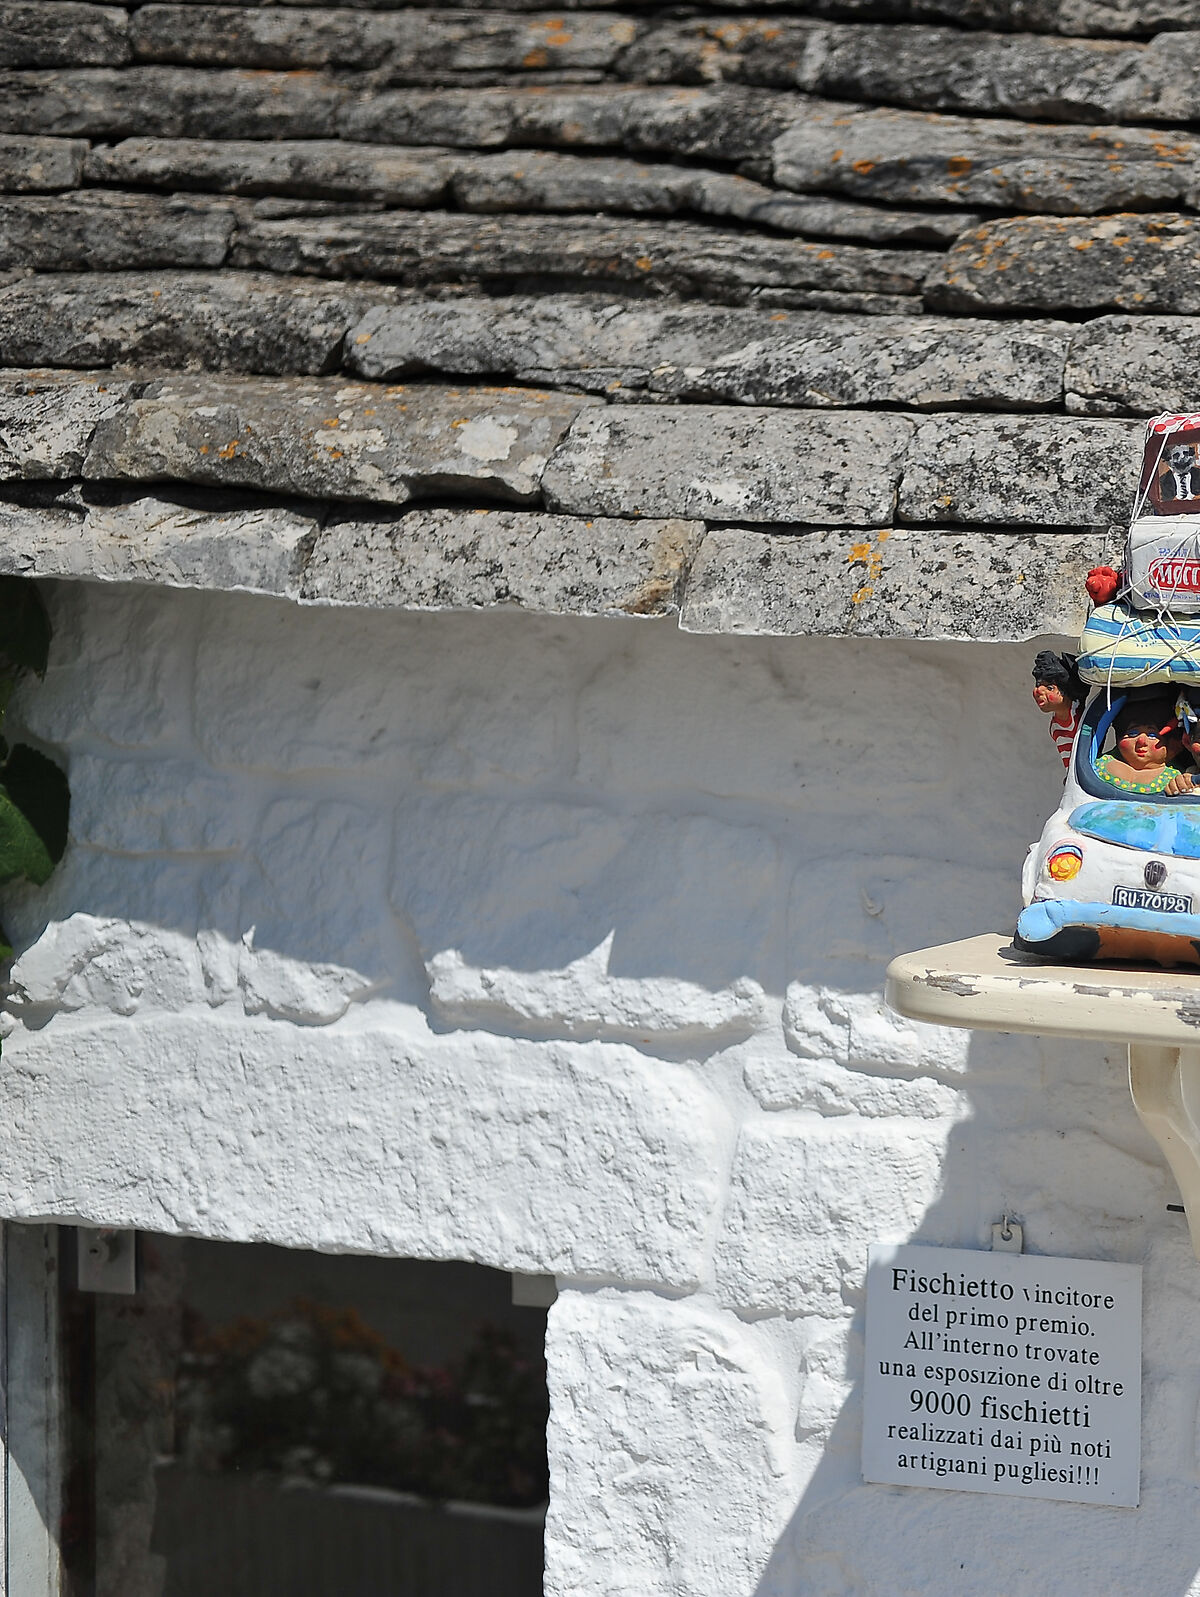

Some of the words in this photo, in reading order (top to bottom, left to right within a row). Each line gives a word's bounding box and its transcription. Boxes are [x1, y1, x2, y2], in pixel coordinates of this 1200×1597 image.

[892, 1268, 1014, 1301] Fischietto
[1023, 1284, 1114, 1310] vincitore
[908, 1303, 939, 1322] del
[946, 1308, 1009, 1330] primo
[1016, 1316, 1096, 1337] premio.
[903, 1330, 1018, 1358] All'interno
[1025, 1344, 1100, 1365] trovate
[879, 1361, 916, 1377] una
[924, 1366, 1041, 1388] esposizione
[1048, 1372, 1067, 1391] di
[1075, 1375, 1124, 1396] oltre
[910, 1390, 971, 1416] 9000
[980, 1396, 1090, 1428] fischietti
[887, 1423, 984, 1446] realizzati
[991, 1430, 1023, 1450] dai
[1030, 1435, 1062, 1458] più
[1070, 1439, 1111, 1459] noti
[898, 1452, 987, 1476] artigiani
[994, 1462, 1099, 1485] pugliesi!!!
